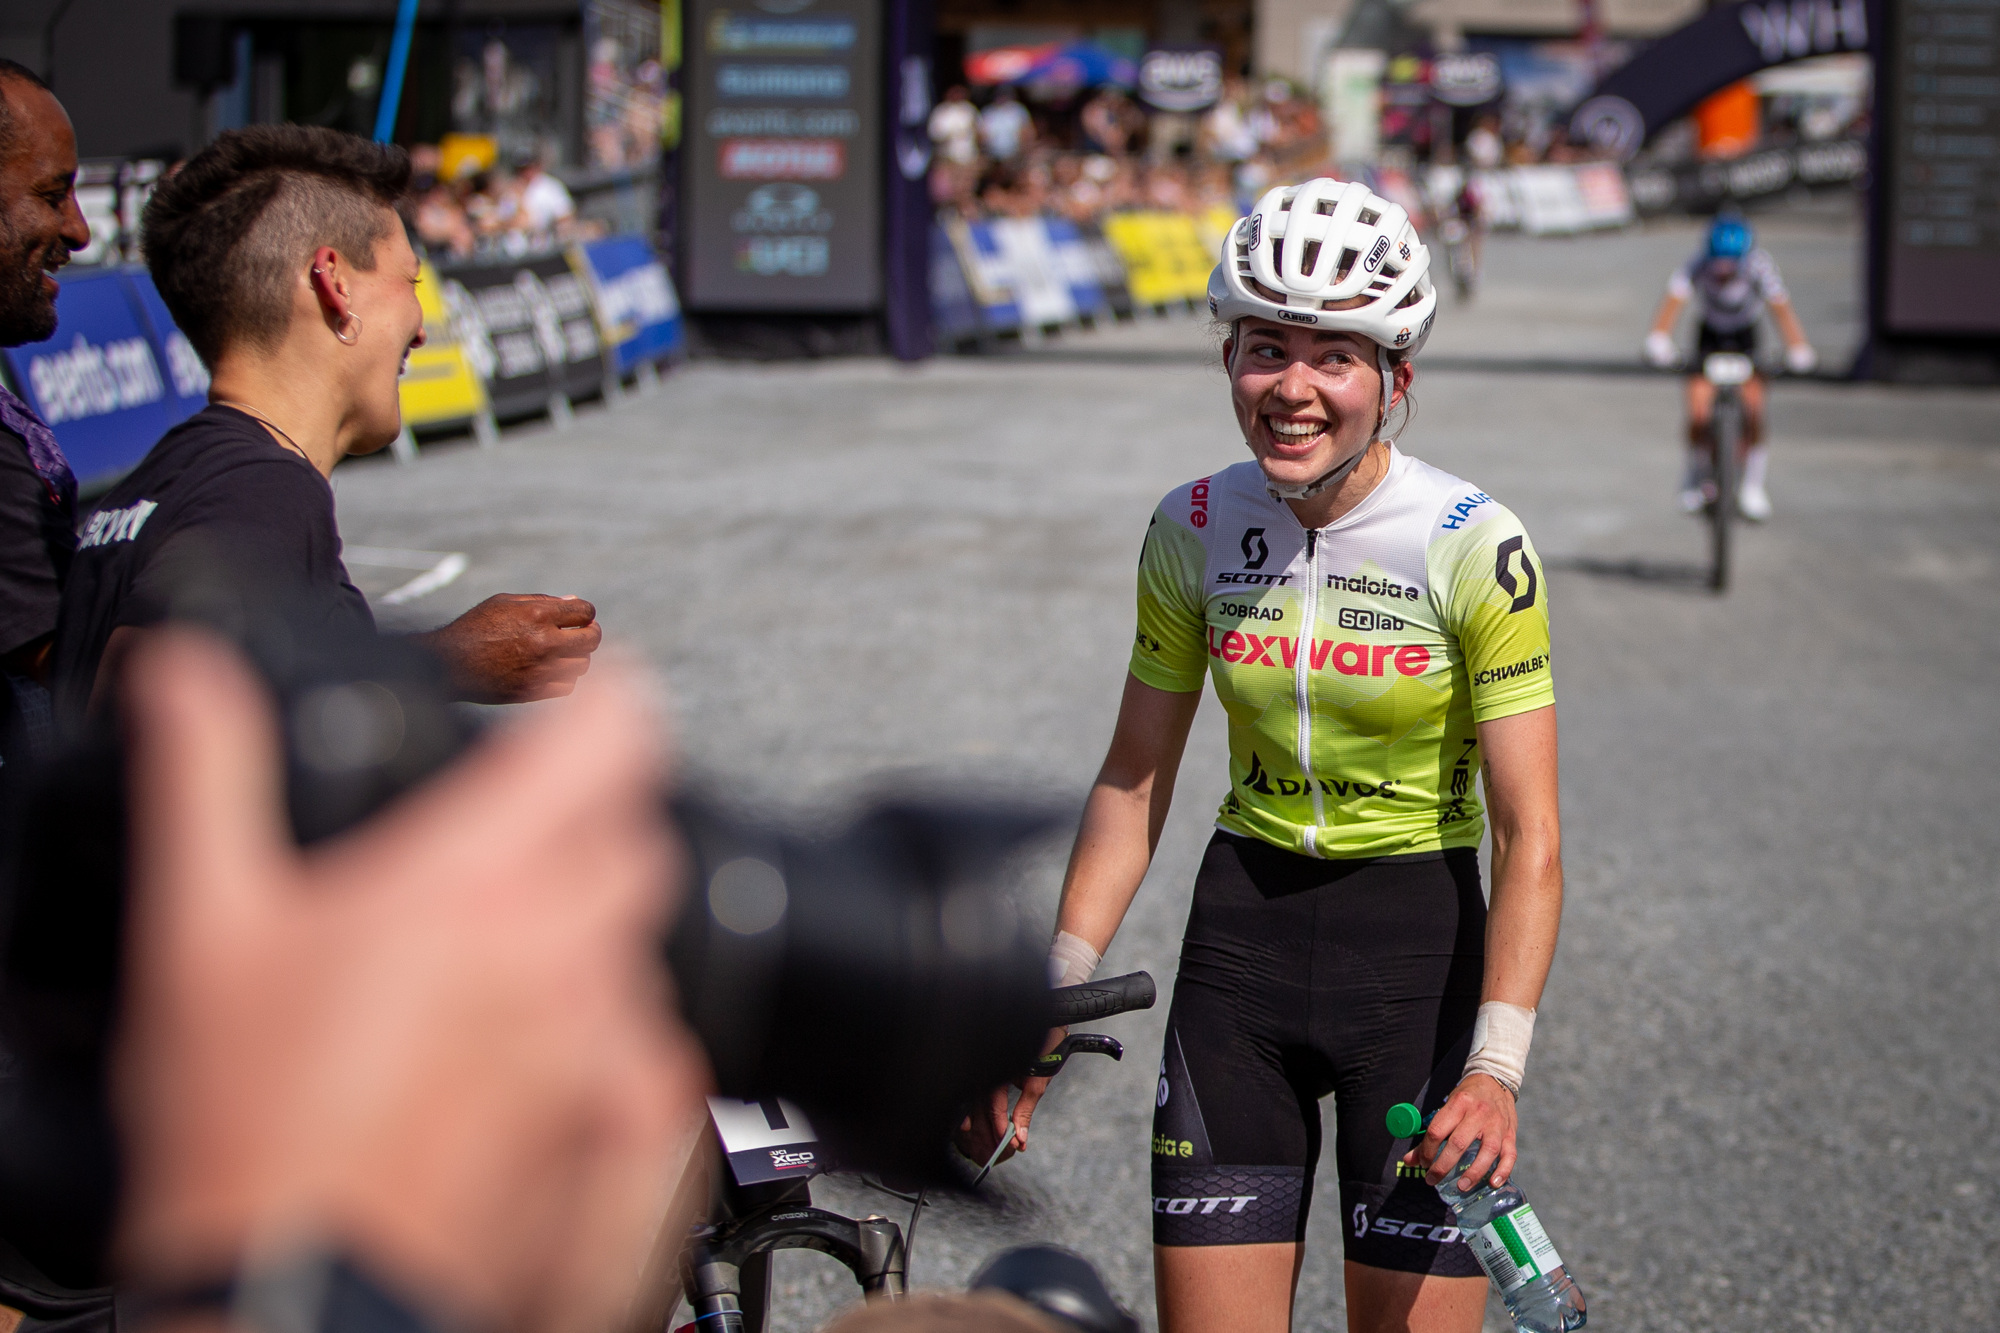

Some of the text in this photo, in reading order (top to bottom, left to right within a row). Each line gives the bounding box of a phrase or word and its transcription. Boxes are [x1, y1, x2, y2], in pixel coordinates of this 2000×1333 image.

[1368, 240, 1388, 270] ABUS
[1283, 312, 1313, 322] ABUS
[1216, 572, 1293, 586] SCOTT
[1327, 573, 1402, 599] maloja
[1219, 602, 1284, 621] JOBRAD
[1208, 625, 1431, 677] Lexware
[1474, 654, 1544, 686] SCHWALBE
[1276, 777, 1397, 799] DAVOS
[771, 1152, 814, 1164] XCO
[1152, 1195, 1258, 1215] COTT
[771, 1212, 809, 1222] CARBON
[1371, 1216, 1467, 1243] SCO
